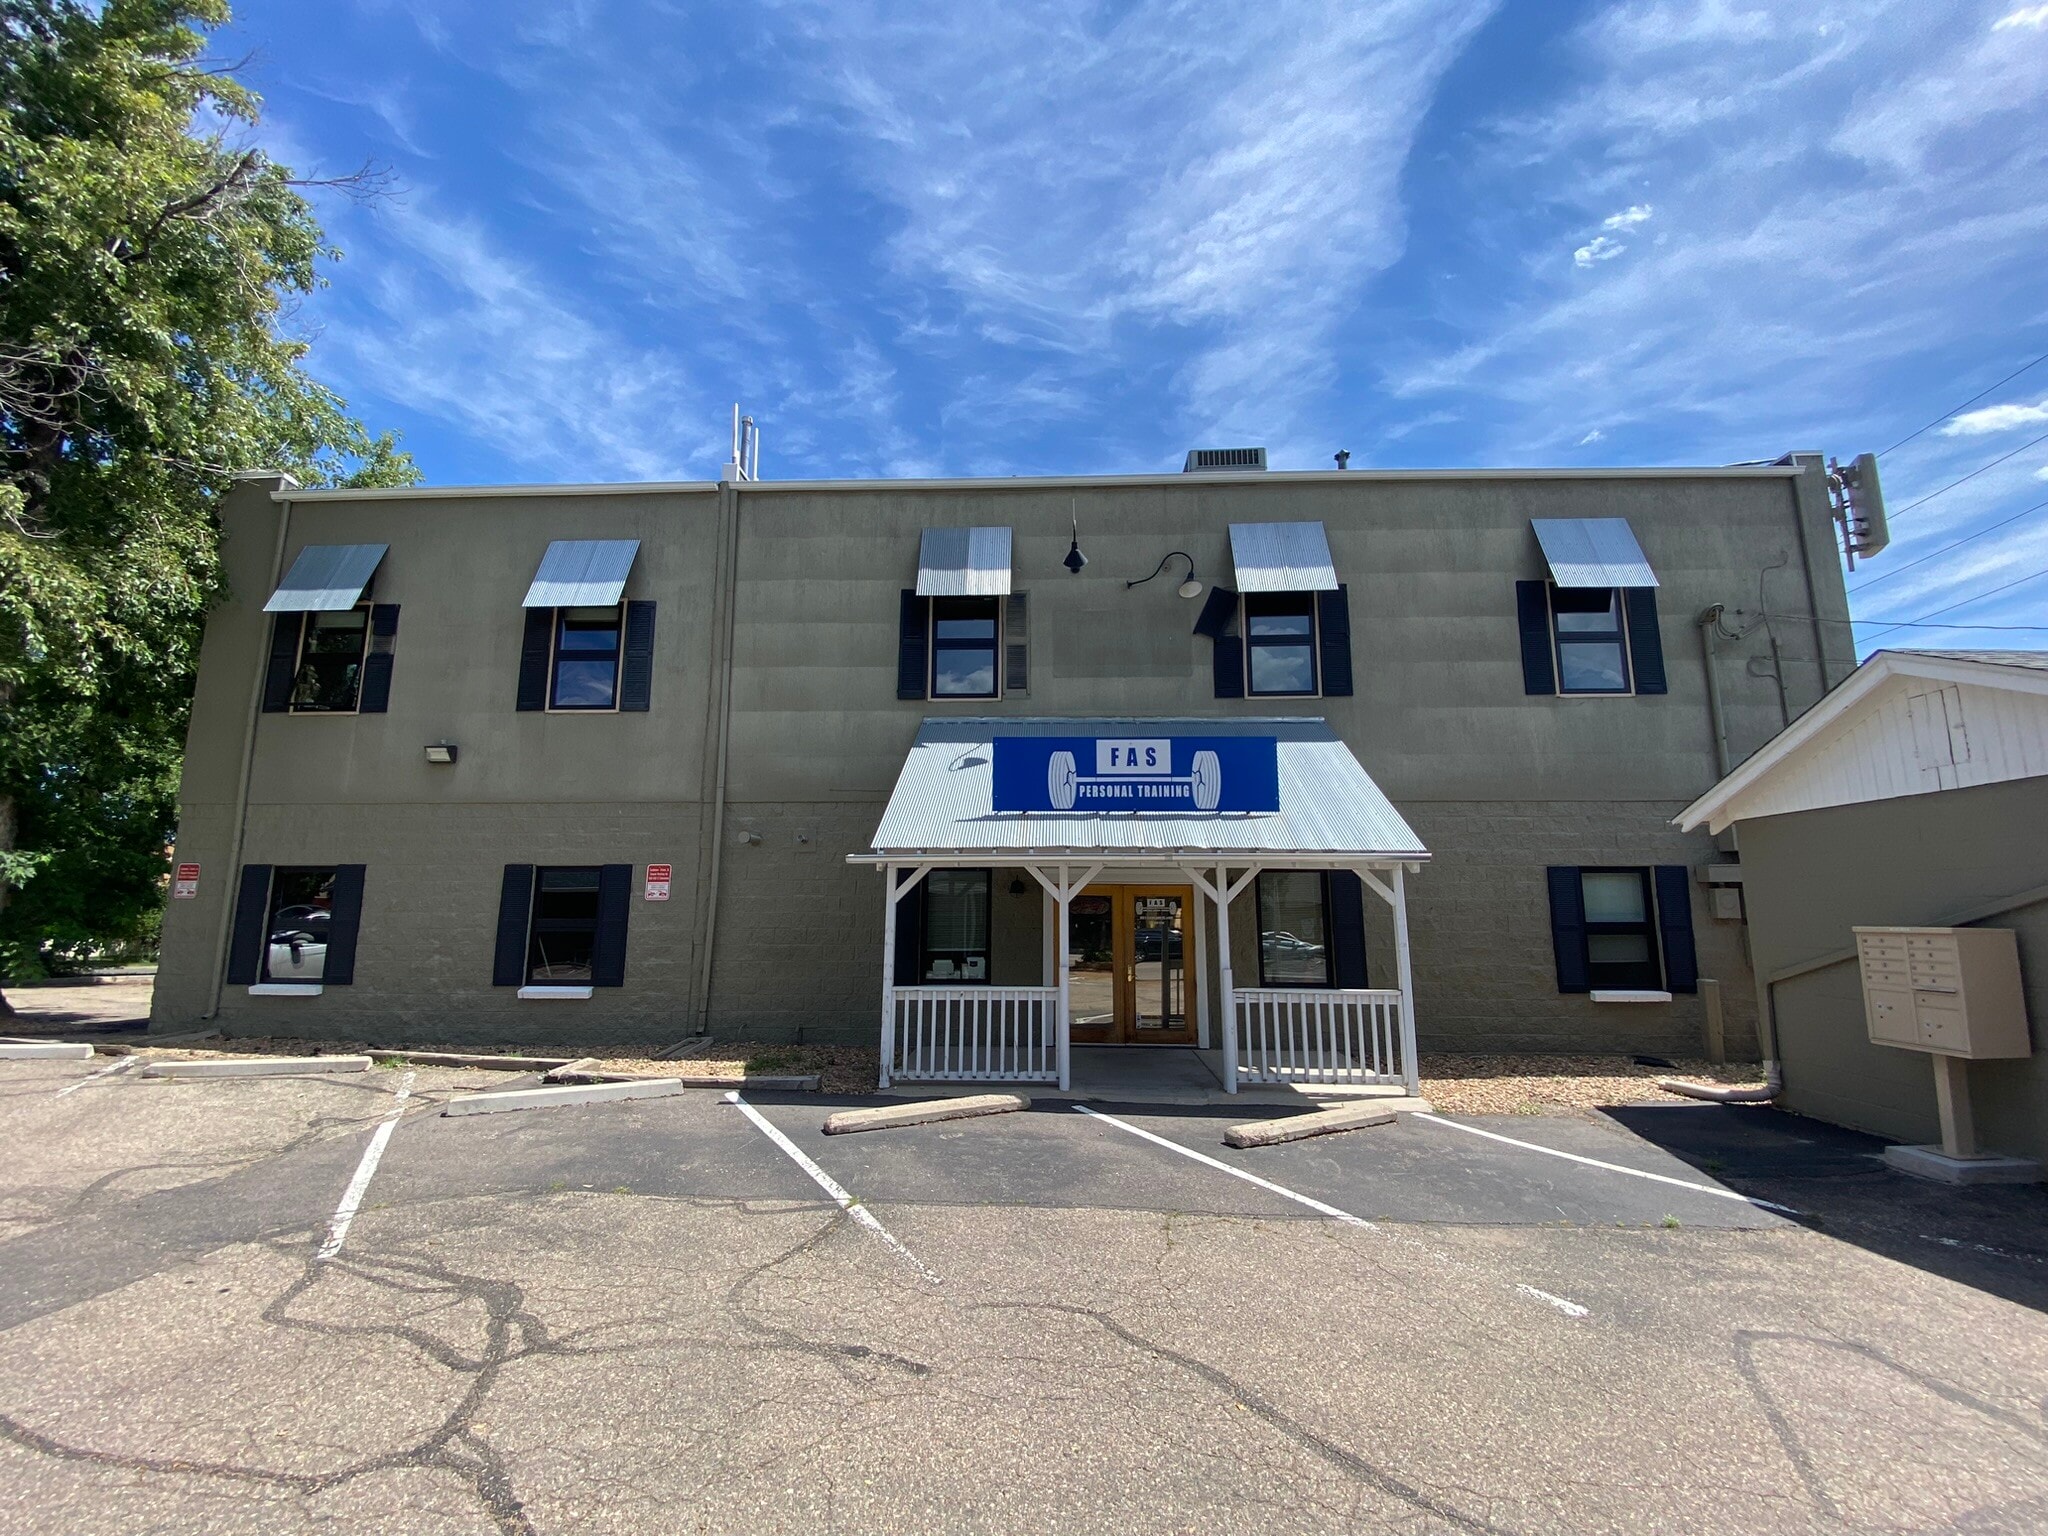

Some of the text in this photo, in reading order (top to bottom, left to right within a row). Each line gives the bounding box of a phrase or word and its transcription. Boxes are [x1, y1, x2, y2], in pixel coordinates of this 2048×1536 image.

[1111, 747, 1156, 766] FAS
[1079, 785, 1190, 797] PERSONAL TRAINING
